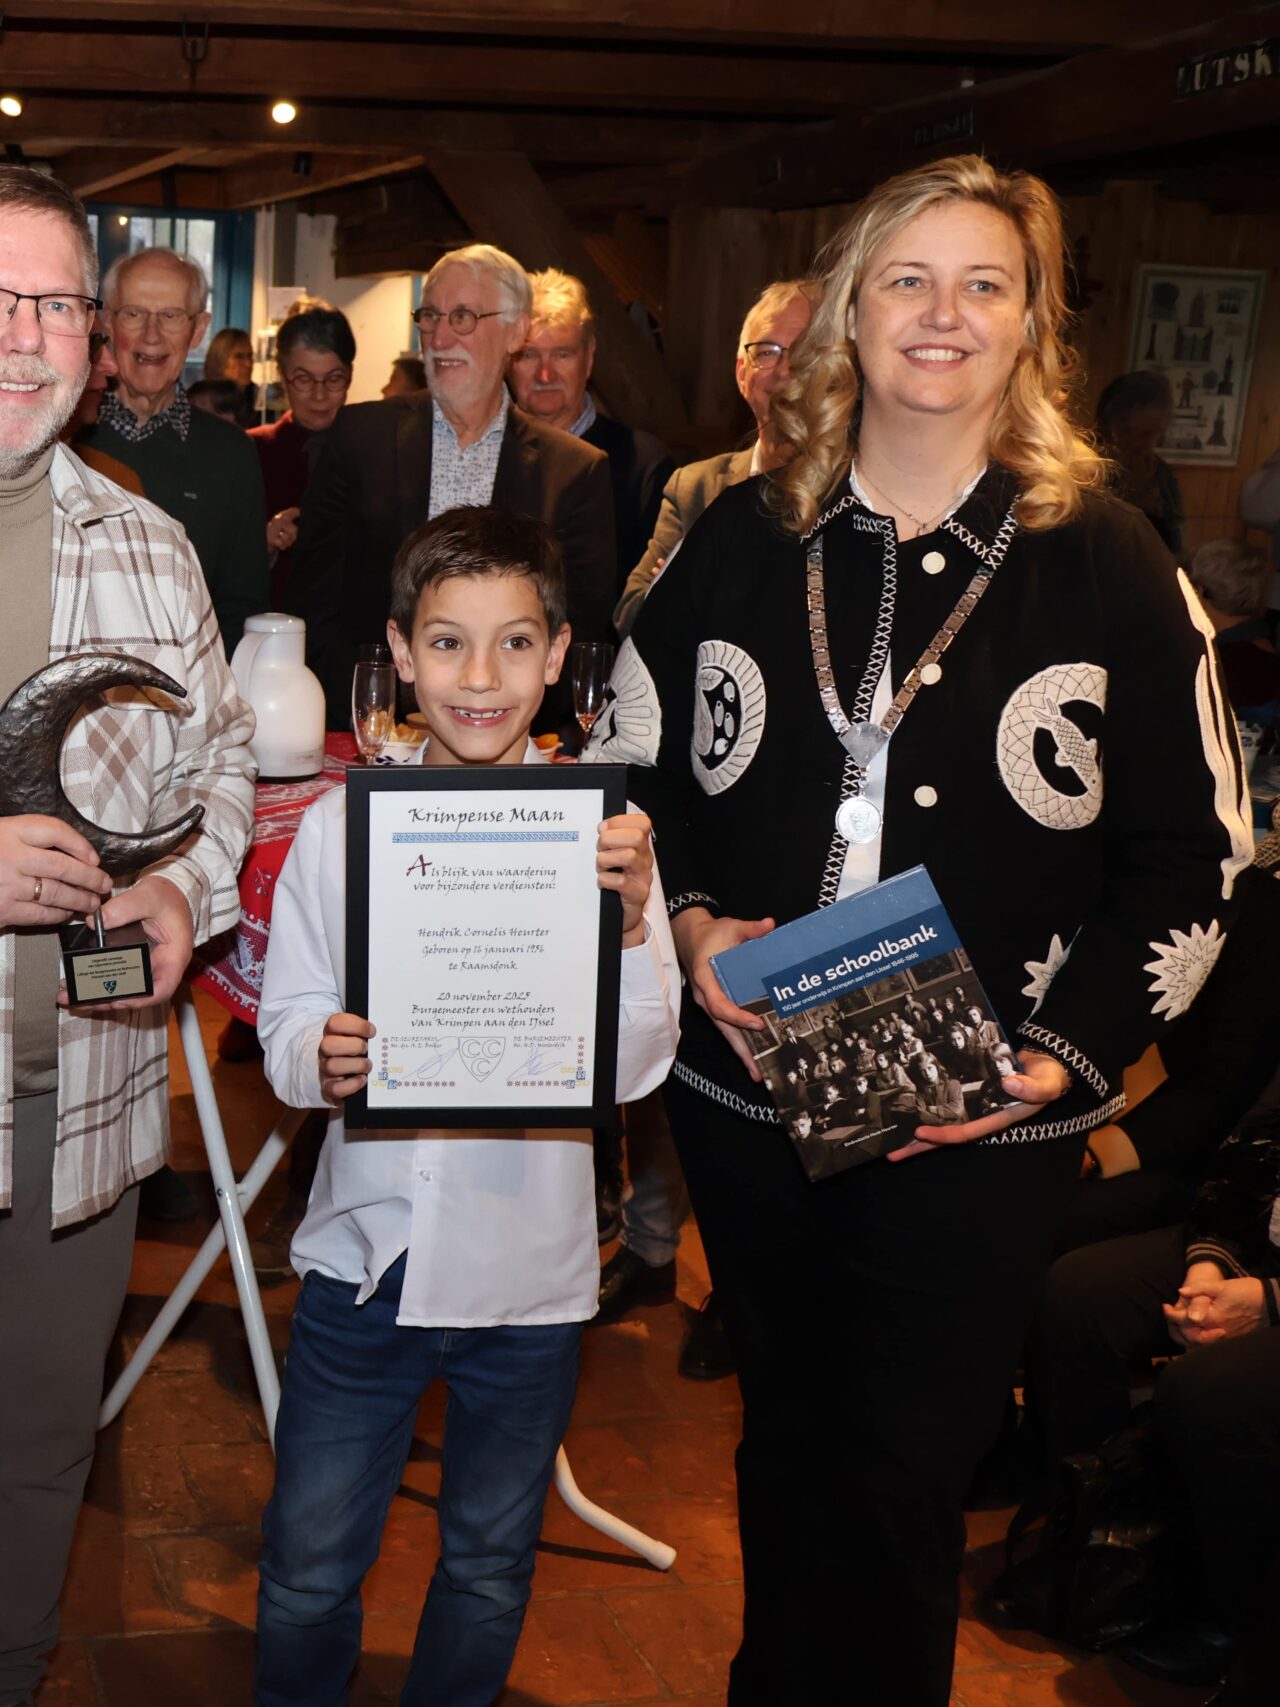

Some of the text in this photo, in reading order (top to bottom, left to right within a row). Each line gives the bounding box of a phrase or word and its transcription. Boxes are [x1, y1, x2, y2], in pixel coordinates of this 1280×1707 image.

[408, 806, 565, 832] Krimpense Maan
[441, 866, 469, 882] blijk
[472, 869, 493, 877] van
[496, 866, 556, 881] waardering
[413, 880, 556, 896] voor bijzondere verdiensten:
[418, 927, 550, 940] Hendrik Cornelis Heurter
[422, 943, 458, 957] Geboren
[461, 946, 471, 957] op
[483, 944, 524, 958] januari
[449, 961, 518, 972] te Raamsdonk
[773, 924, 938, 1002] In de schoolbank
[436, 990, 531, 1002] 20 november 2025
[790, 1000, 803, 1010] jaar
[801, 989, 828, 1004] onderwijs
[832, 977, 855, 992] Krimpen
[854, 974, 866, 982] aan
[865, 969, 876, 978] den
[411, 1004, 480, 1019] Burgemeester
[498, 1003, 555, 1017] wethouders
[411, 1018, 554, 1031] van Krimpen aan den IJssel
